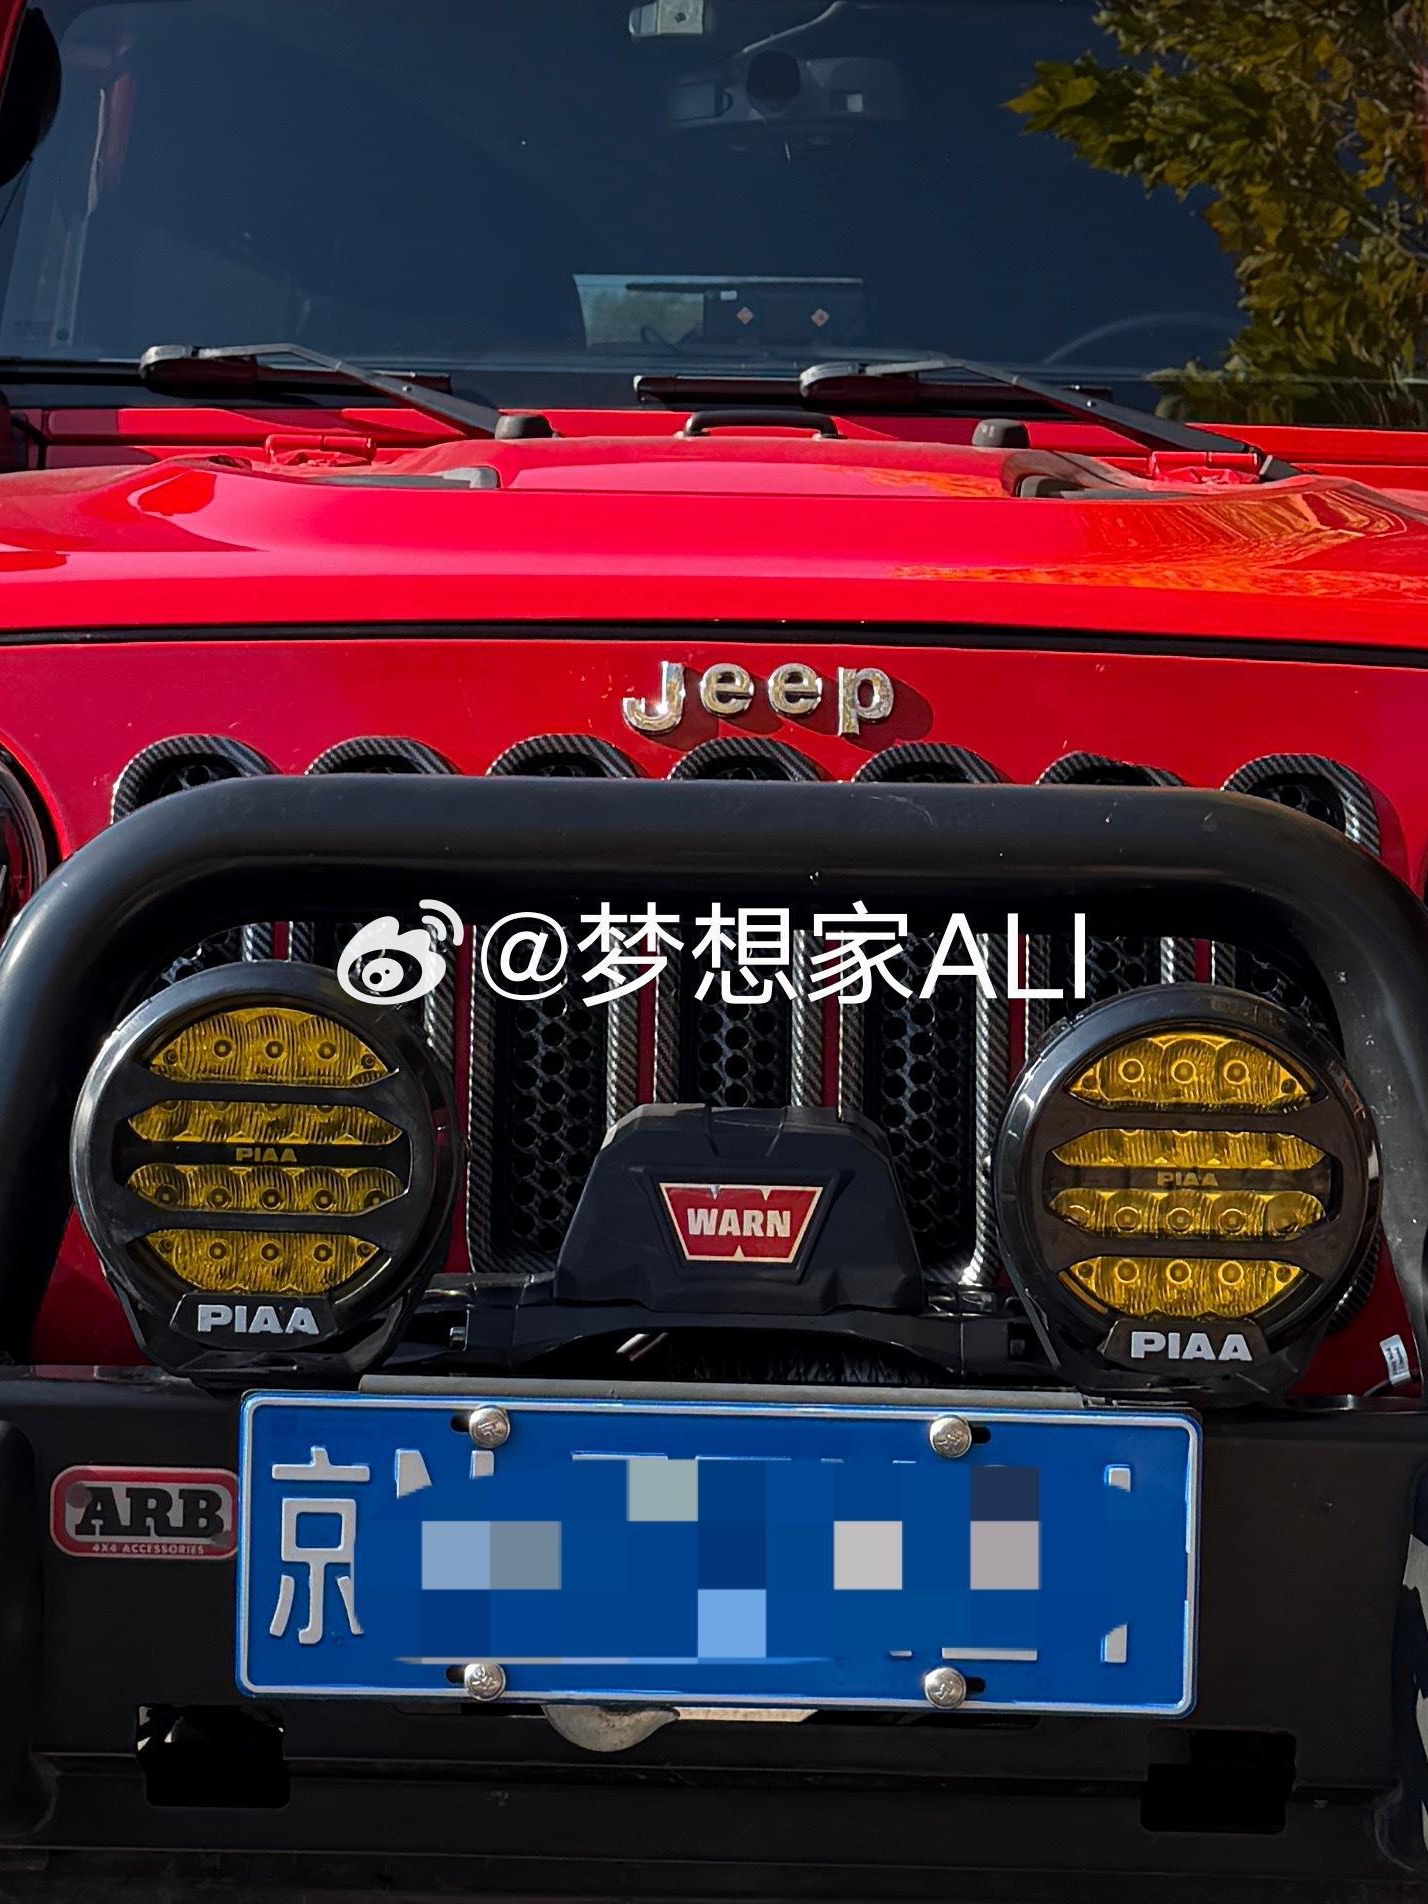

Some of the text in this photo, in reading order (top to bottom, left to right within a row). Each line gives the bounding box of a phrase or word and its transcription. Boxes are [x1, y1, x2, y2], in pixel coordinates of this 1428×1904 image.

[622, 661, 895, 736] Jeep
[235, 1146, 298, 1163] PIAA
[1156, 1171, 1219, 1187] PIAA
[686, 1207, 791, 1237] WARN
[197, 1304, 320, 1334] PIAA
[1130, 1331, 1253, 1361] PIAA
[74, 1486, 224, 1538] ARB
[122, 1543, 205, 1556] ACCESSORIES
